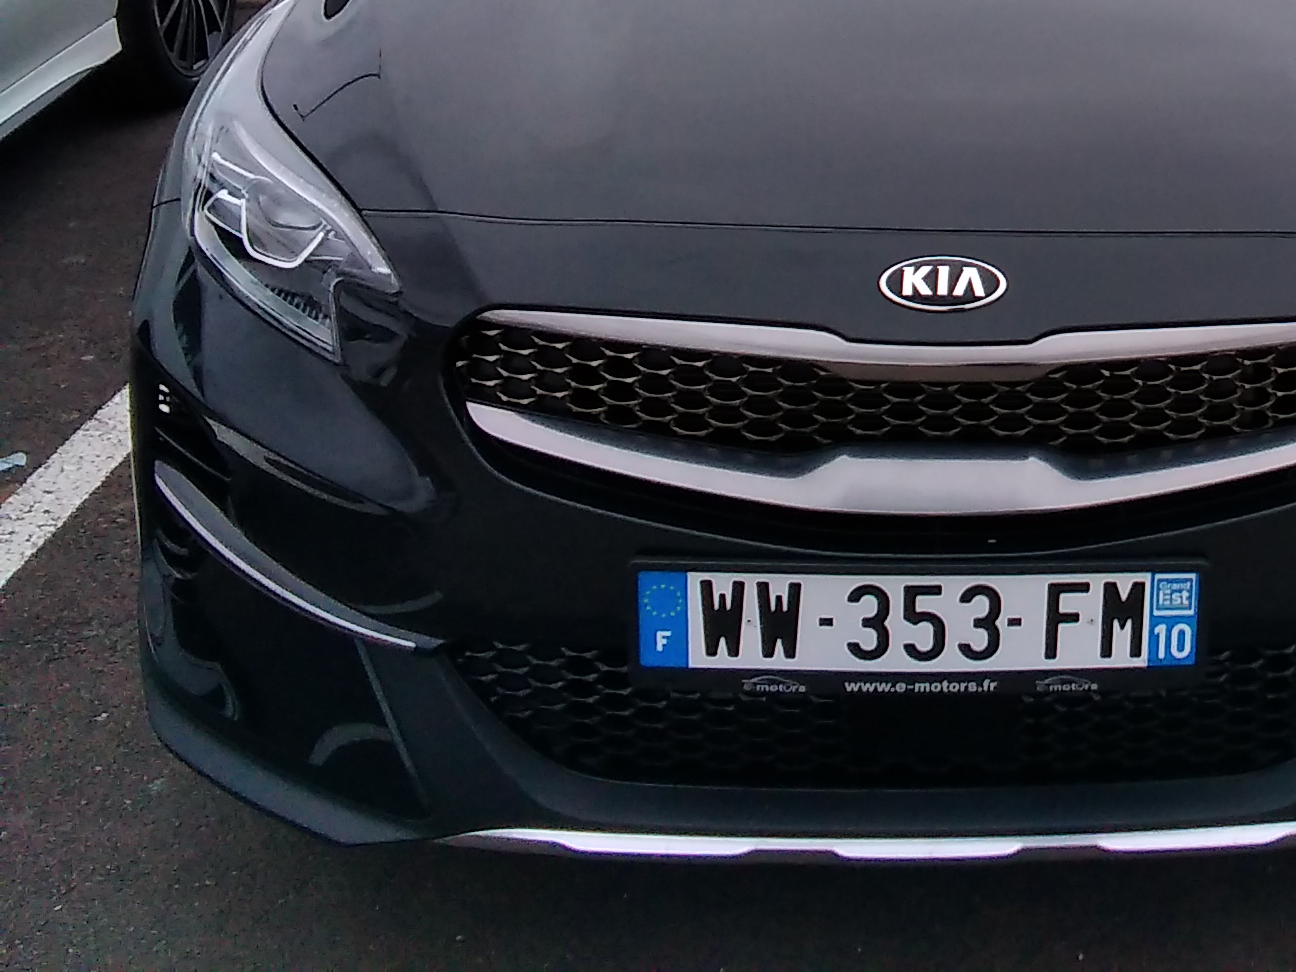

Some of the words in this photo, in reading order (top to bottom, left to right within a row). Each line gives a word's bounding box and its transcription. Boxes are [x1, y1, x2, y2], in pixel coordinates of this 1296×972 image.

[901, 266, 986, 297] KIA
[656, 630, 672, 652] F
[1154, 623, 1192, 660] 10
[844, 679, 998, 693] www.e-motors.fr
